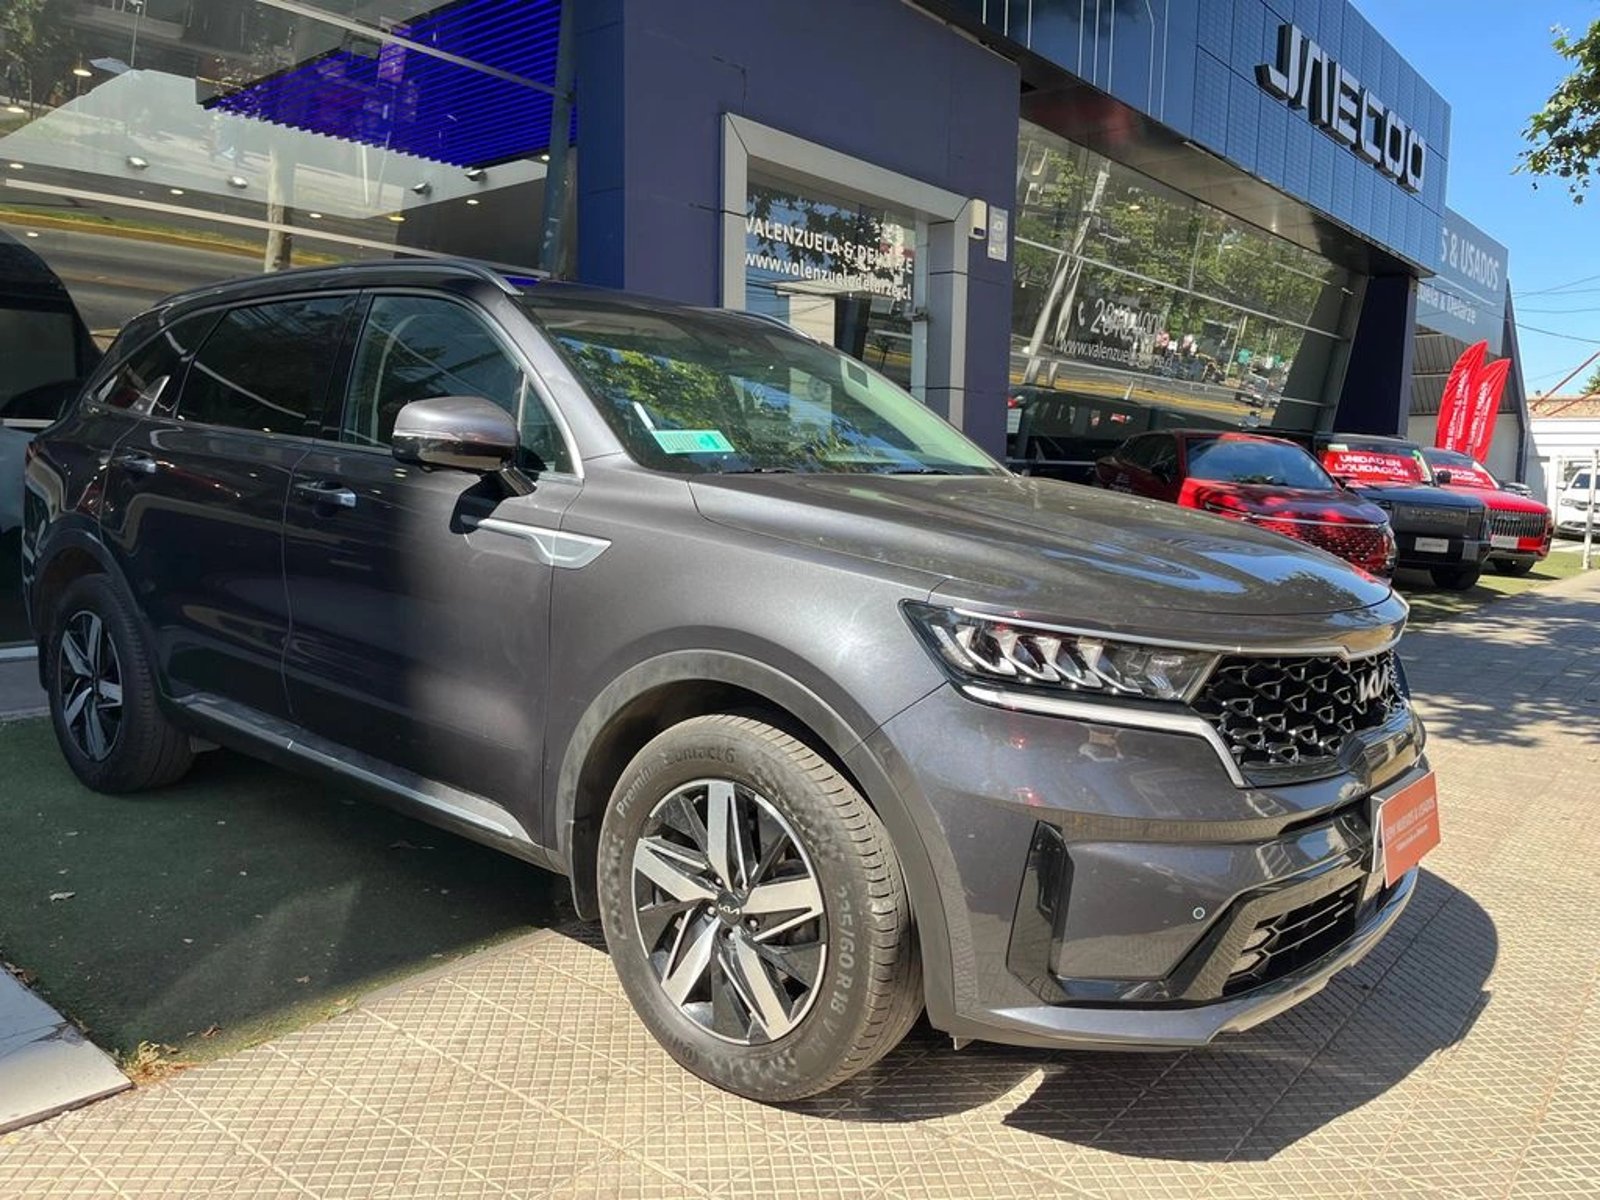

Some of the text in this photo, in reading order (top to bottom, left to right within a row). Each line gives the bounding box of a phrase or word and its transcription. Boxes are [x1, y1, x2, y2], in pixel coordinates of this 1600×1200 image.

[1255, 23, 1426, 193] JAECOO
[744, 215, 840, 257] VALENZUELA
[1460, 238, 1499, 292] USADOS
[1339, 454, 1384, 466] UNIDAD
